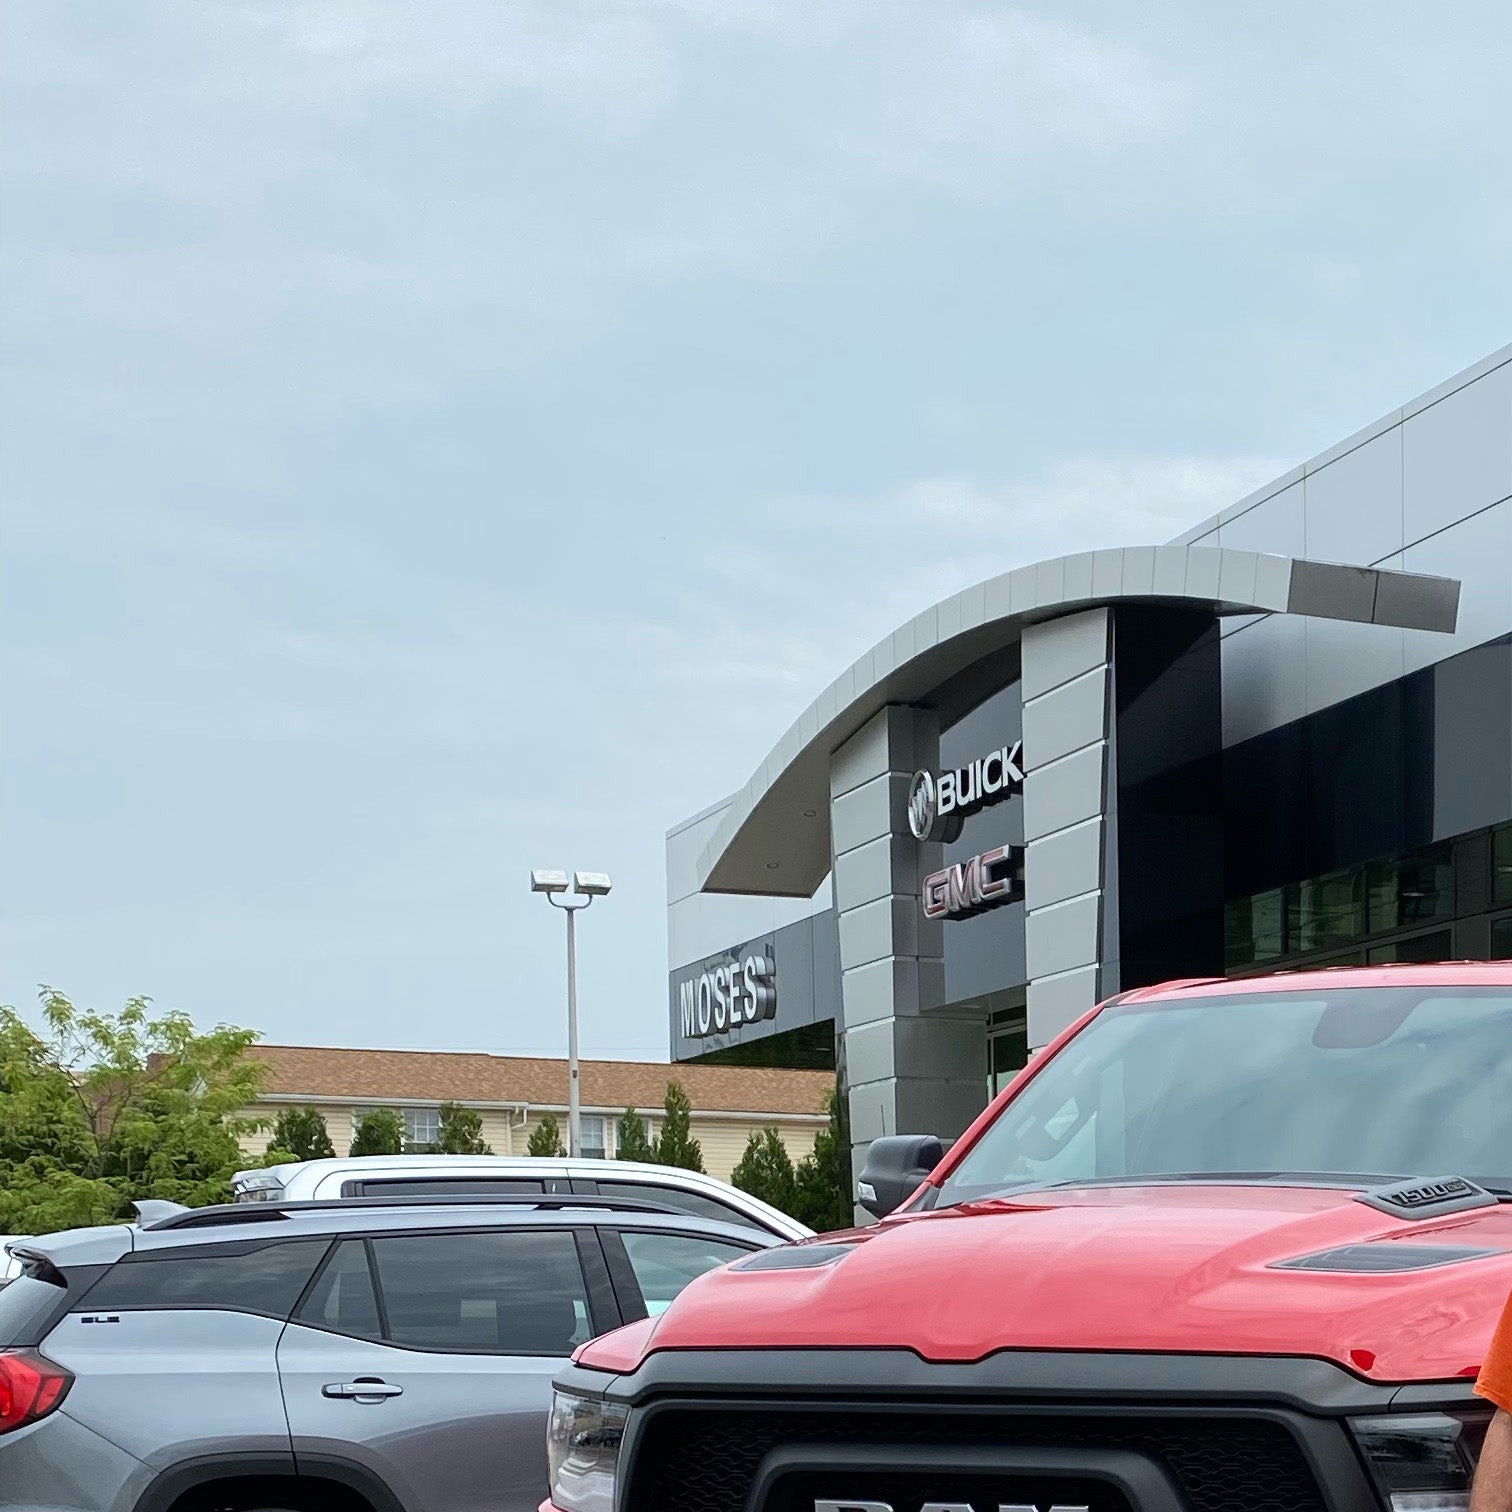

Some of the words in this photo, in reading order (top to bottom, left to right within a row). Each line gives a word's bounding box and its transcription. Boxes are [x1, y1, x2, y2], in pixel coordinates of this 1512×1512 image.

[936, 739, 1025, 817] BUICK
[922, 843, 1013, 918] GMC
[680, 955, 762, 1038] MOSES
